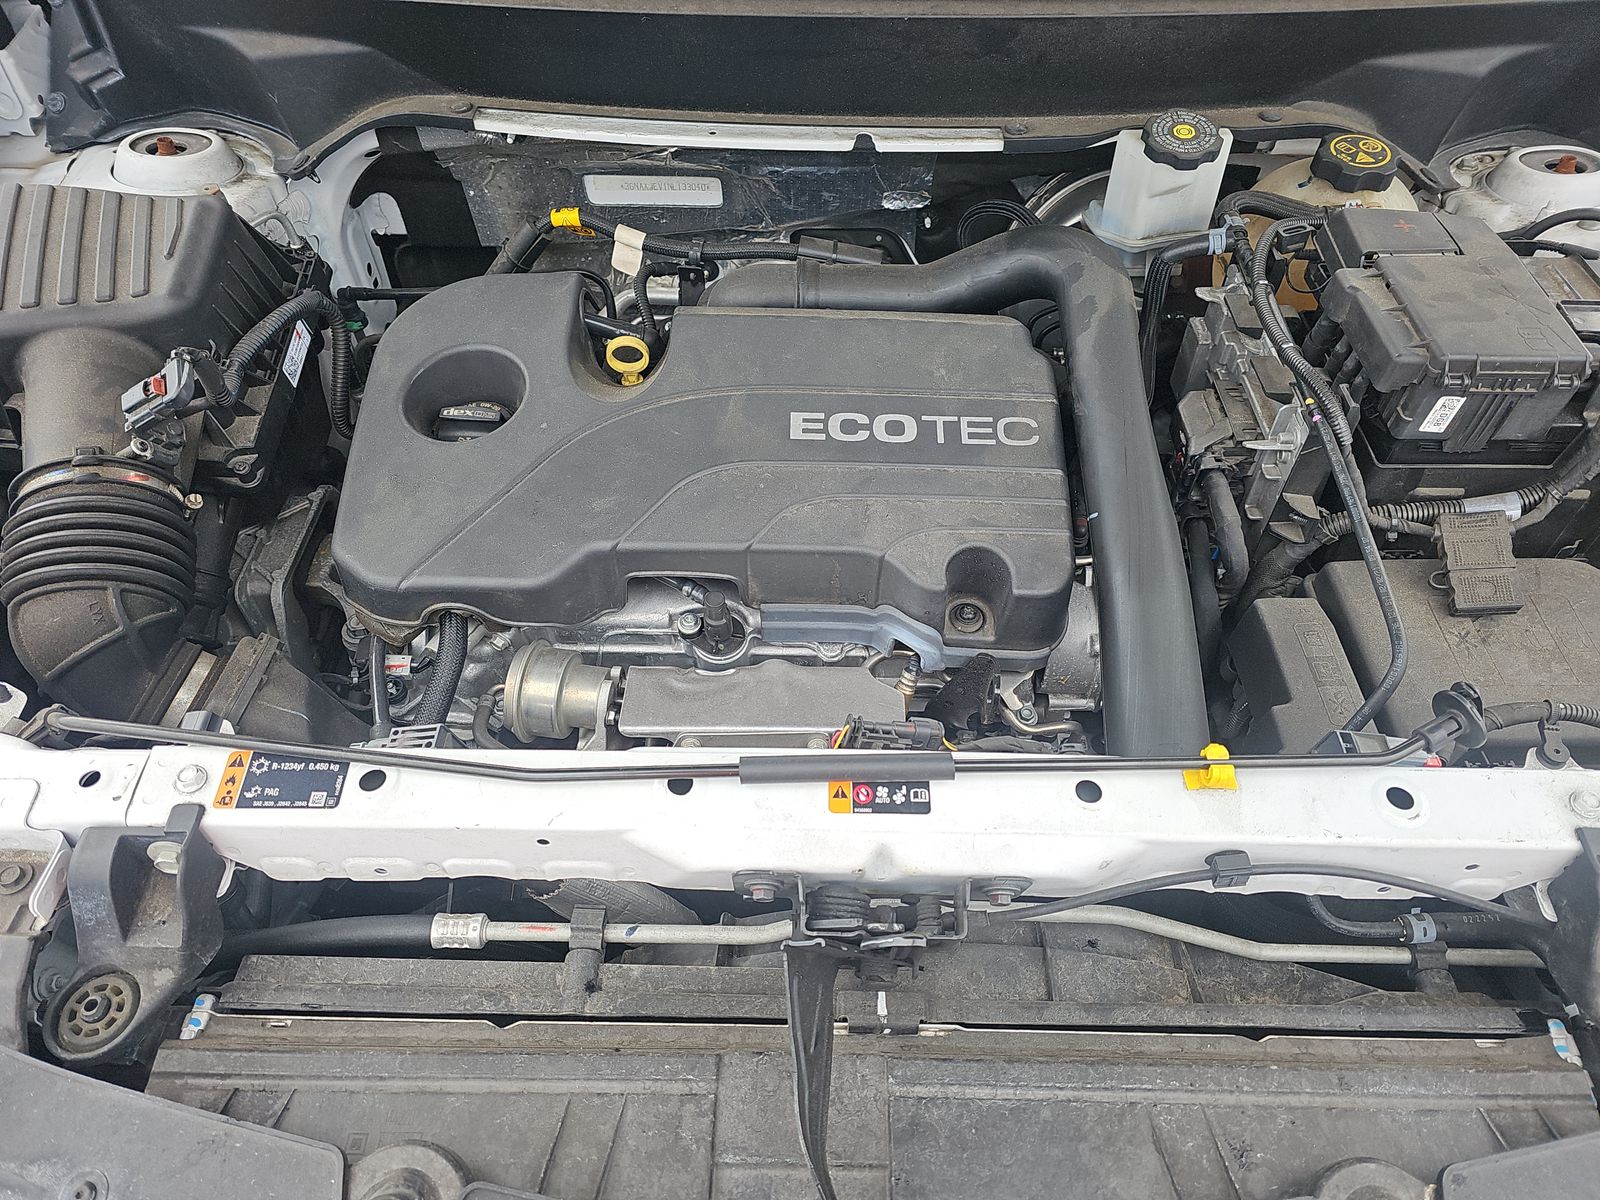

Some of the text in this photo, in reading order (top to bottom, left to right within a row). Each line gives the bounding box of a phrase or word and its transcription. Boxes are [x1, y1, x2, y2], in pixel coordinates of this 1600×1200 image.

[789, 411, 1040, 446] ECOTEC
[271, 762, 340, 772] R-1234yf 0.450 kg
[264, 787, 280, 797] PAG
